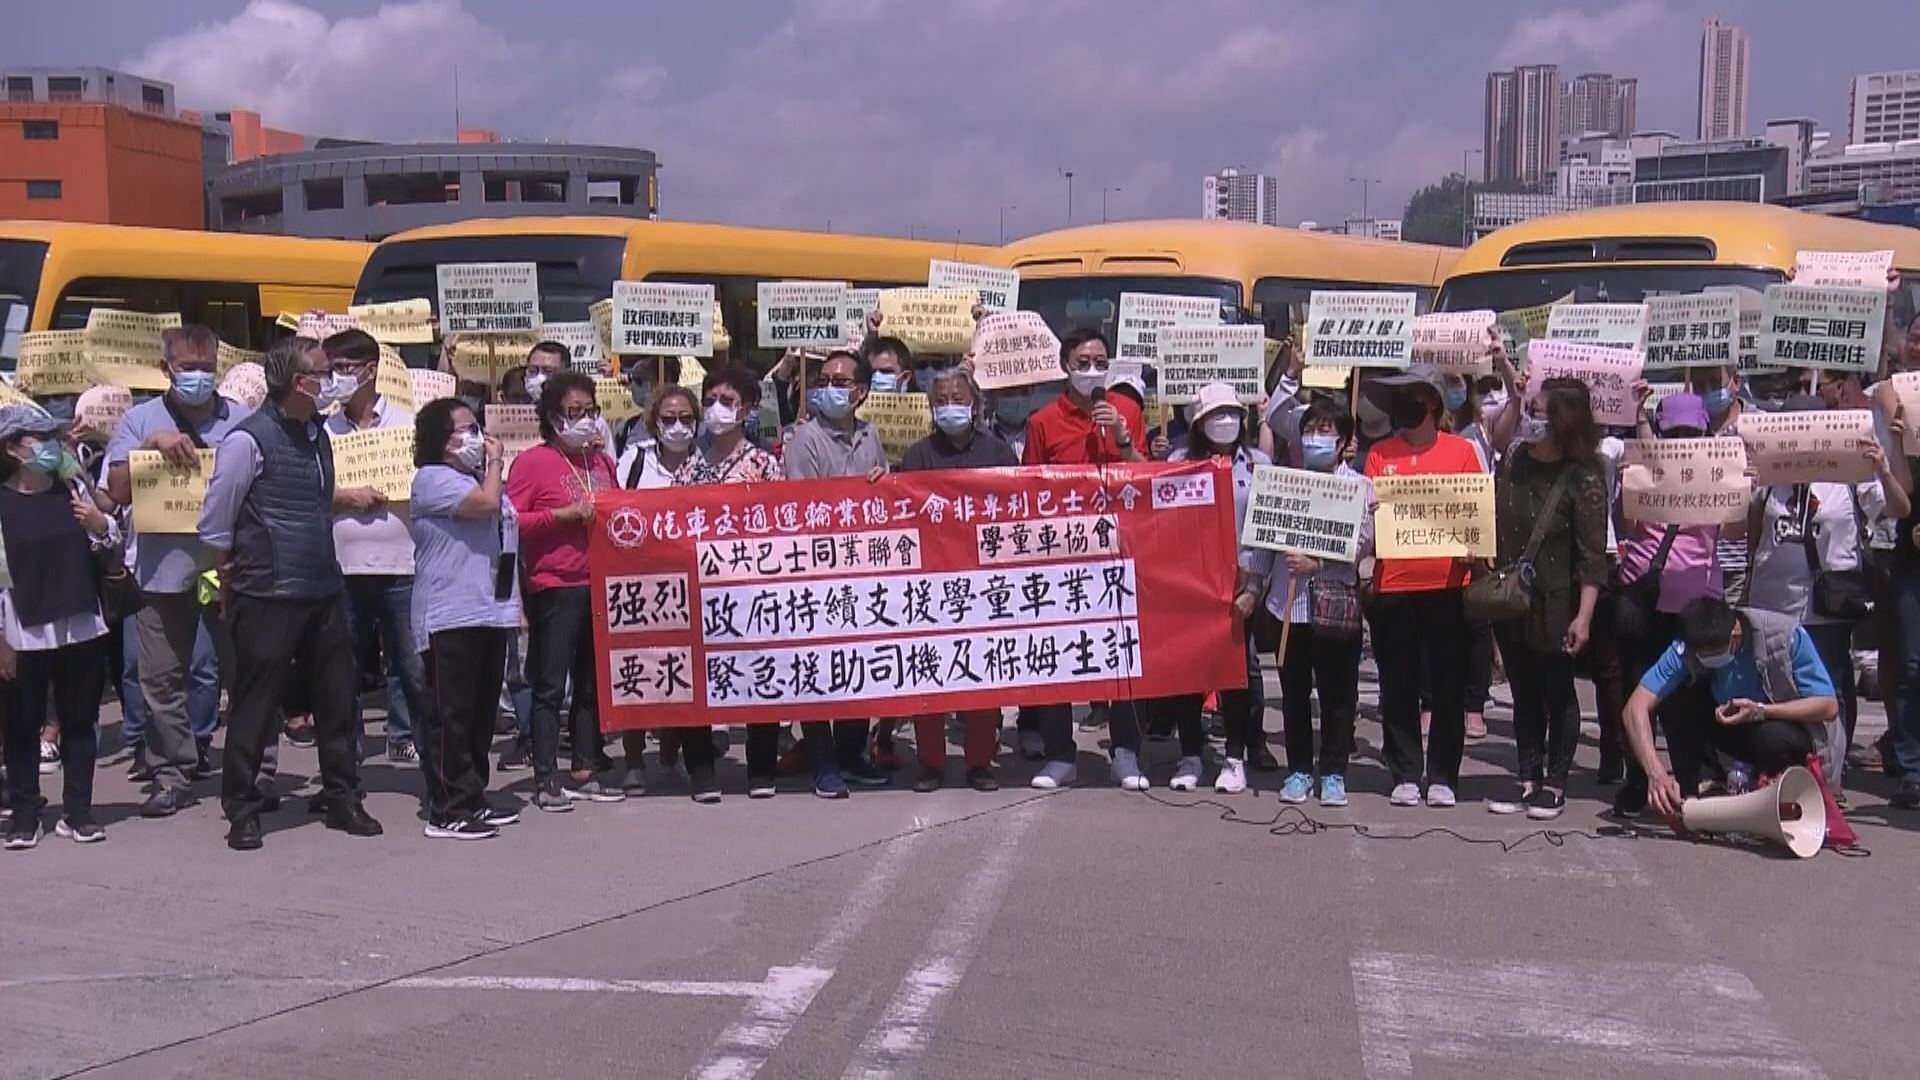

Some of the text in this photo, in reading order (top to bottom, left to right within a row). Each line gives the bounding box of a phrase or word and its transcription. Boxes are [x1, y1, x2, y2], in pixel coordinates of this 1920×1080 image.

[622, 308, 701, 328] 政府唔幫手
[768, 306, 837, 321] 停課不停學
[624, 330, 703, 348] 我們就放手
[1772, 315, 1867, 340] 停課三個月
[1312, 339, 1405, 359] 政府救救救校巴
[1774, 339, 1867, 366] 點會捱得住
[652, 483, 1142, 540] 汽車交通運輸業總工會非專利巴士分會
[1393, 502, 1479, 521] 停課不停學
[980, 517, 1116, 559] 學童車協會
[1395, 527, 1481, 546] 校巴好大鑊
[700, 533, 918, 576] 公共巴士同業聯會
[703, 566, 1135, 637] 政府持續支援學童車業界
[613, 651, 692, 698] 要求
